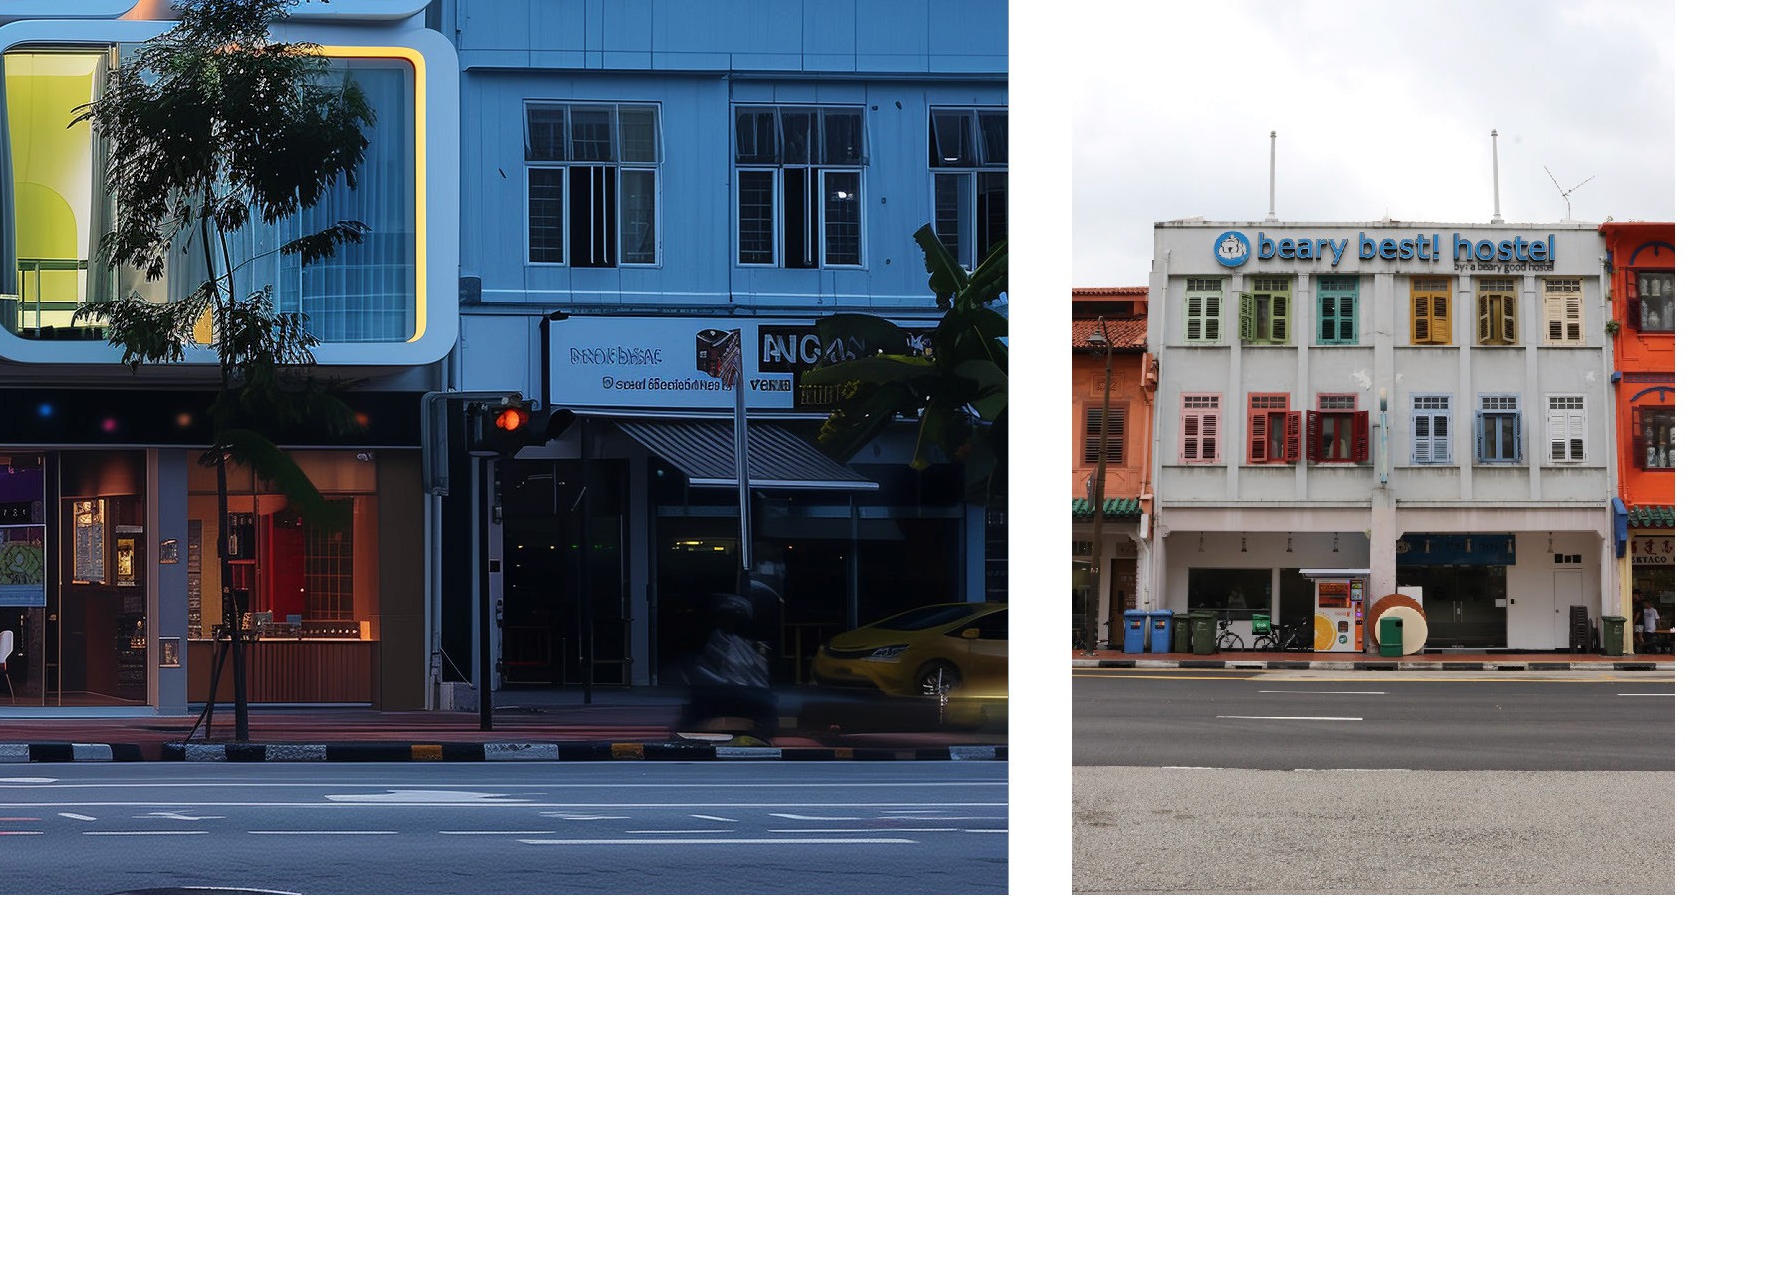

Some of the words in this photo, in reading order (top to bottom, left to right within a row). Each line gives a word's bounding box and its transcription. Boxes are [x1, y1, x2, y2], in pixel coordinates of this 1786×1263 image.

[1258, 232, 1348, 267] beary
[1358, 232, 1439, 261] best!
[1453, 233, 1555, 262] hostel
[1478, 262, 1502, 273] beary
[1504, 262, 1527, 274] good
[1528, 262, 1555, 272] hostel
